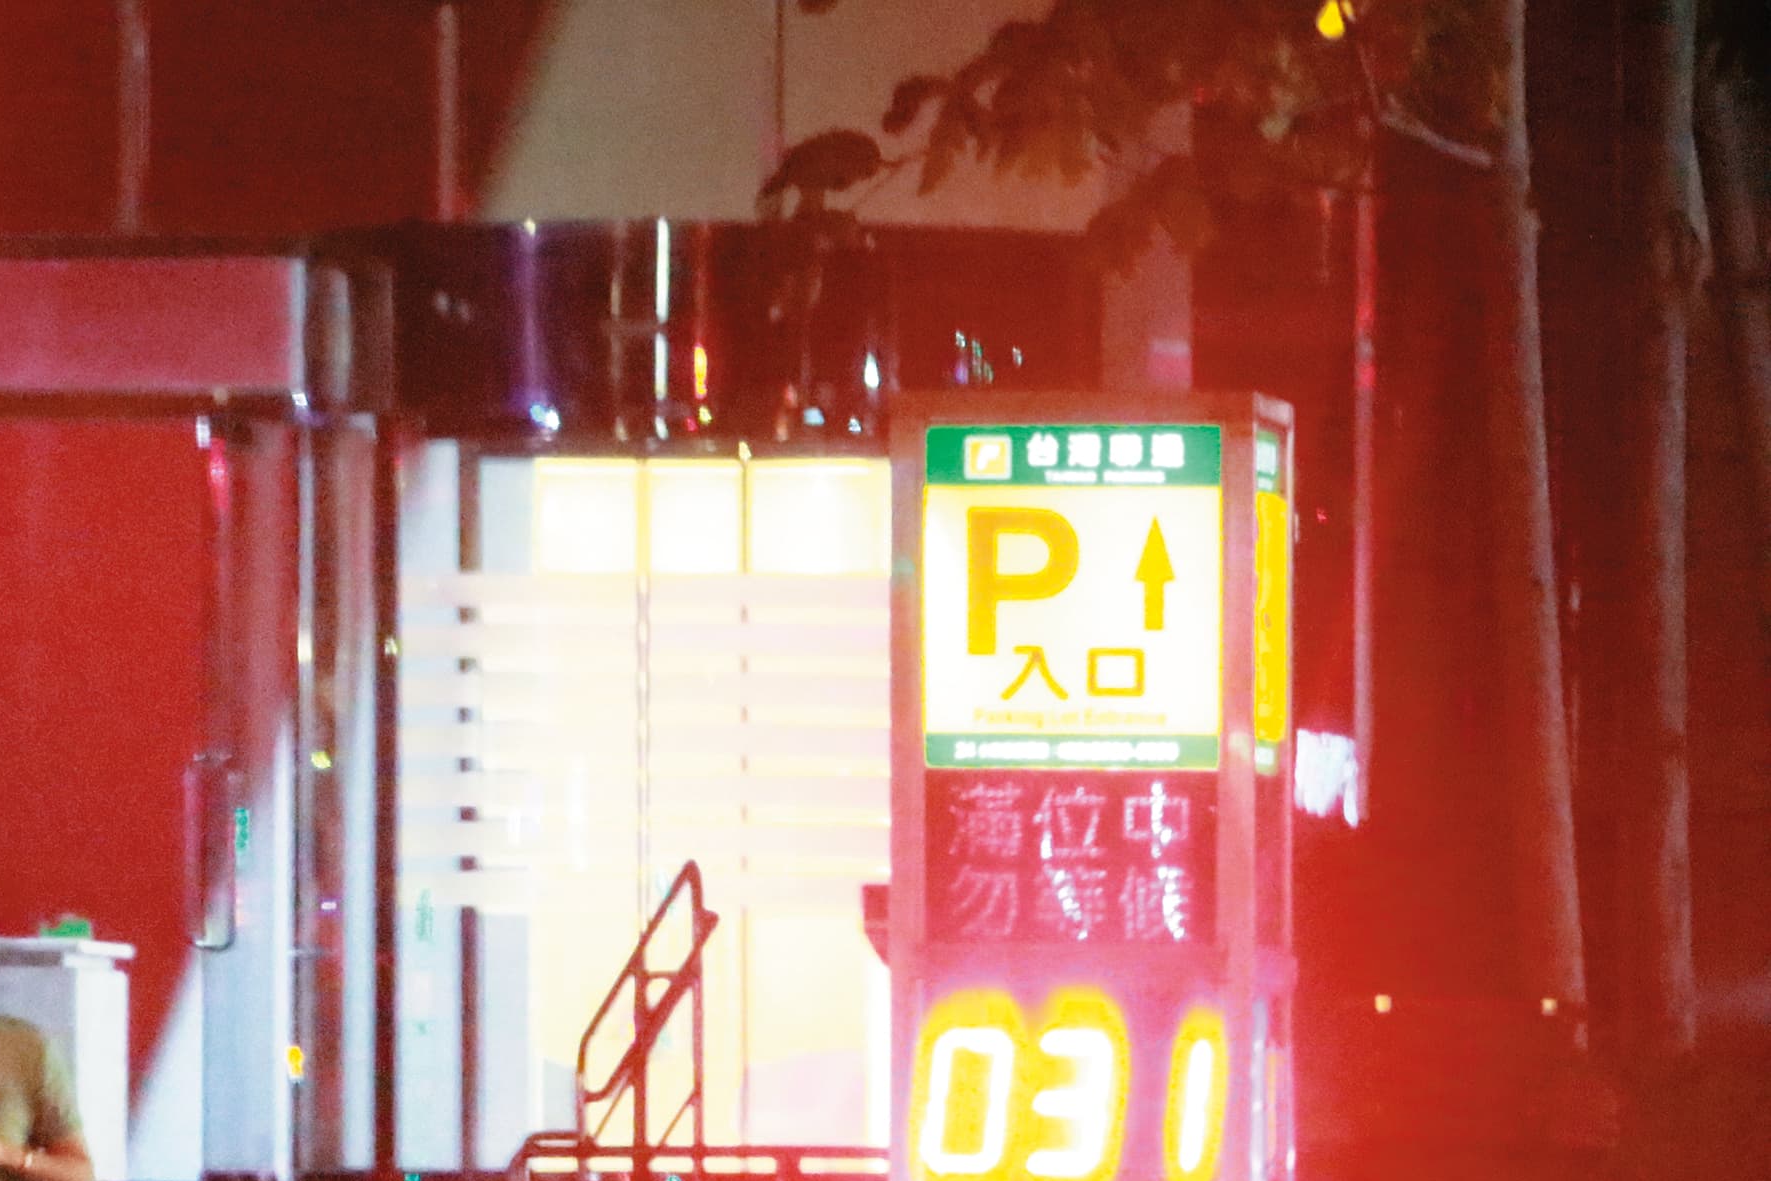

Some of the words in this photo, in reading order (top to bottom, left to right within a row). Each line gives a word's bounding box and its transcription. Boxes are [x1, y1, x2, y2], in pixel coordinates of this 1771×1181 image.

[967, 506, 1079, 655] P
[1000, 645, 1145, 700] 入口
[918, 1026, 1214, 1179] 031
